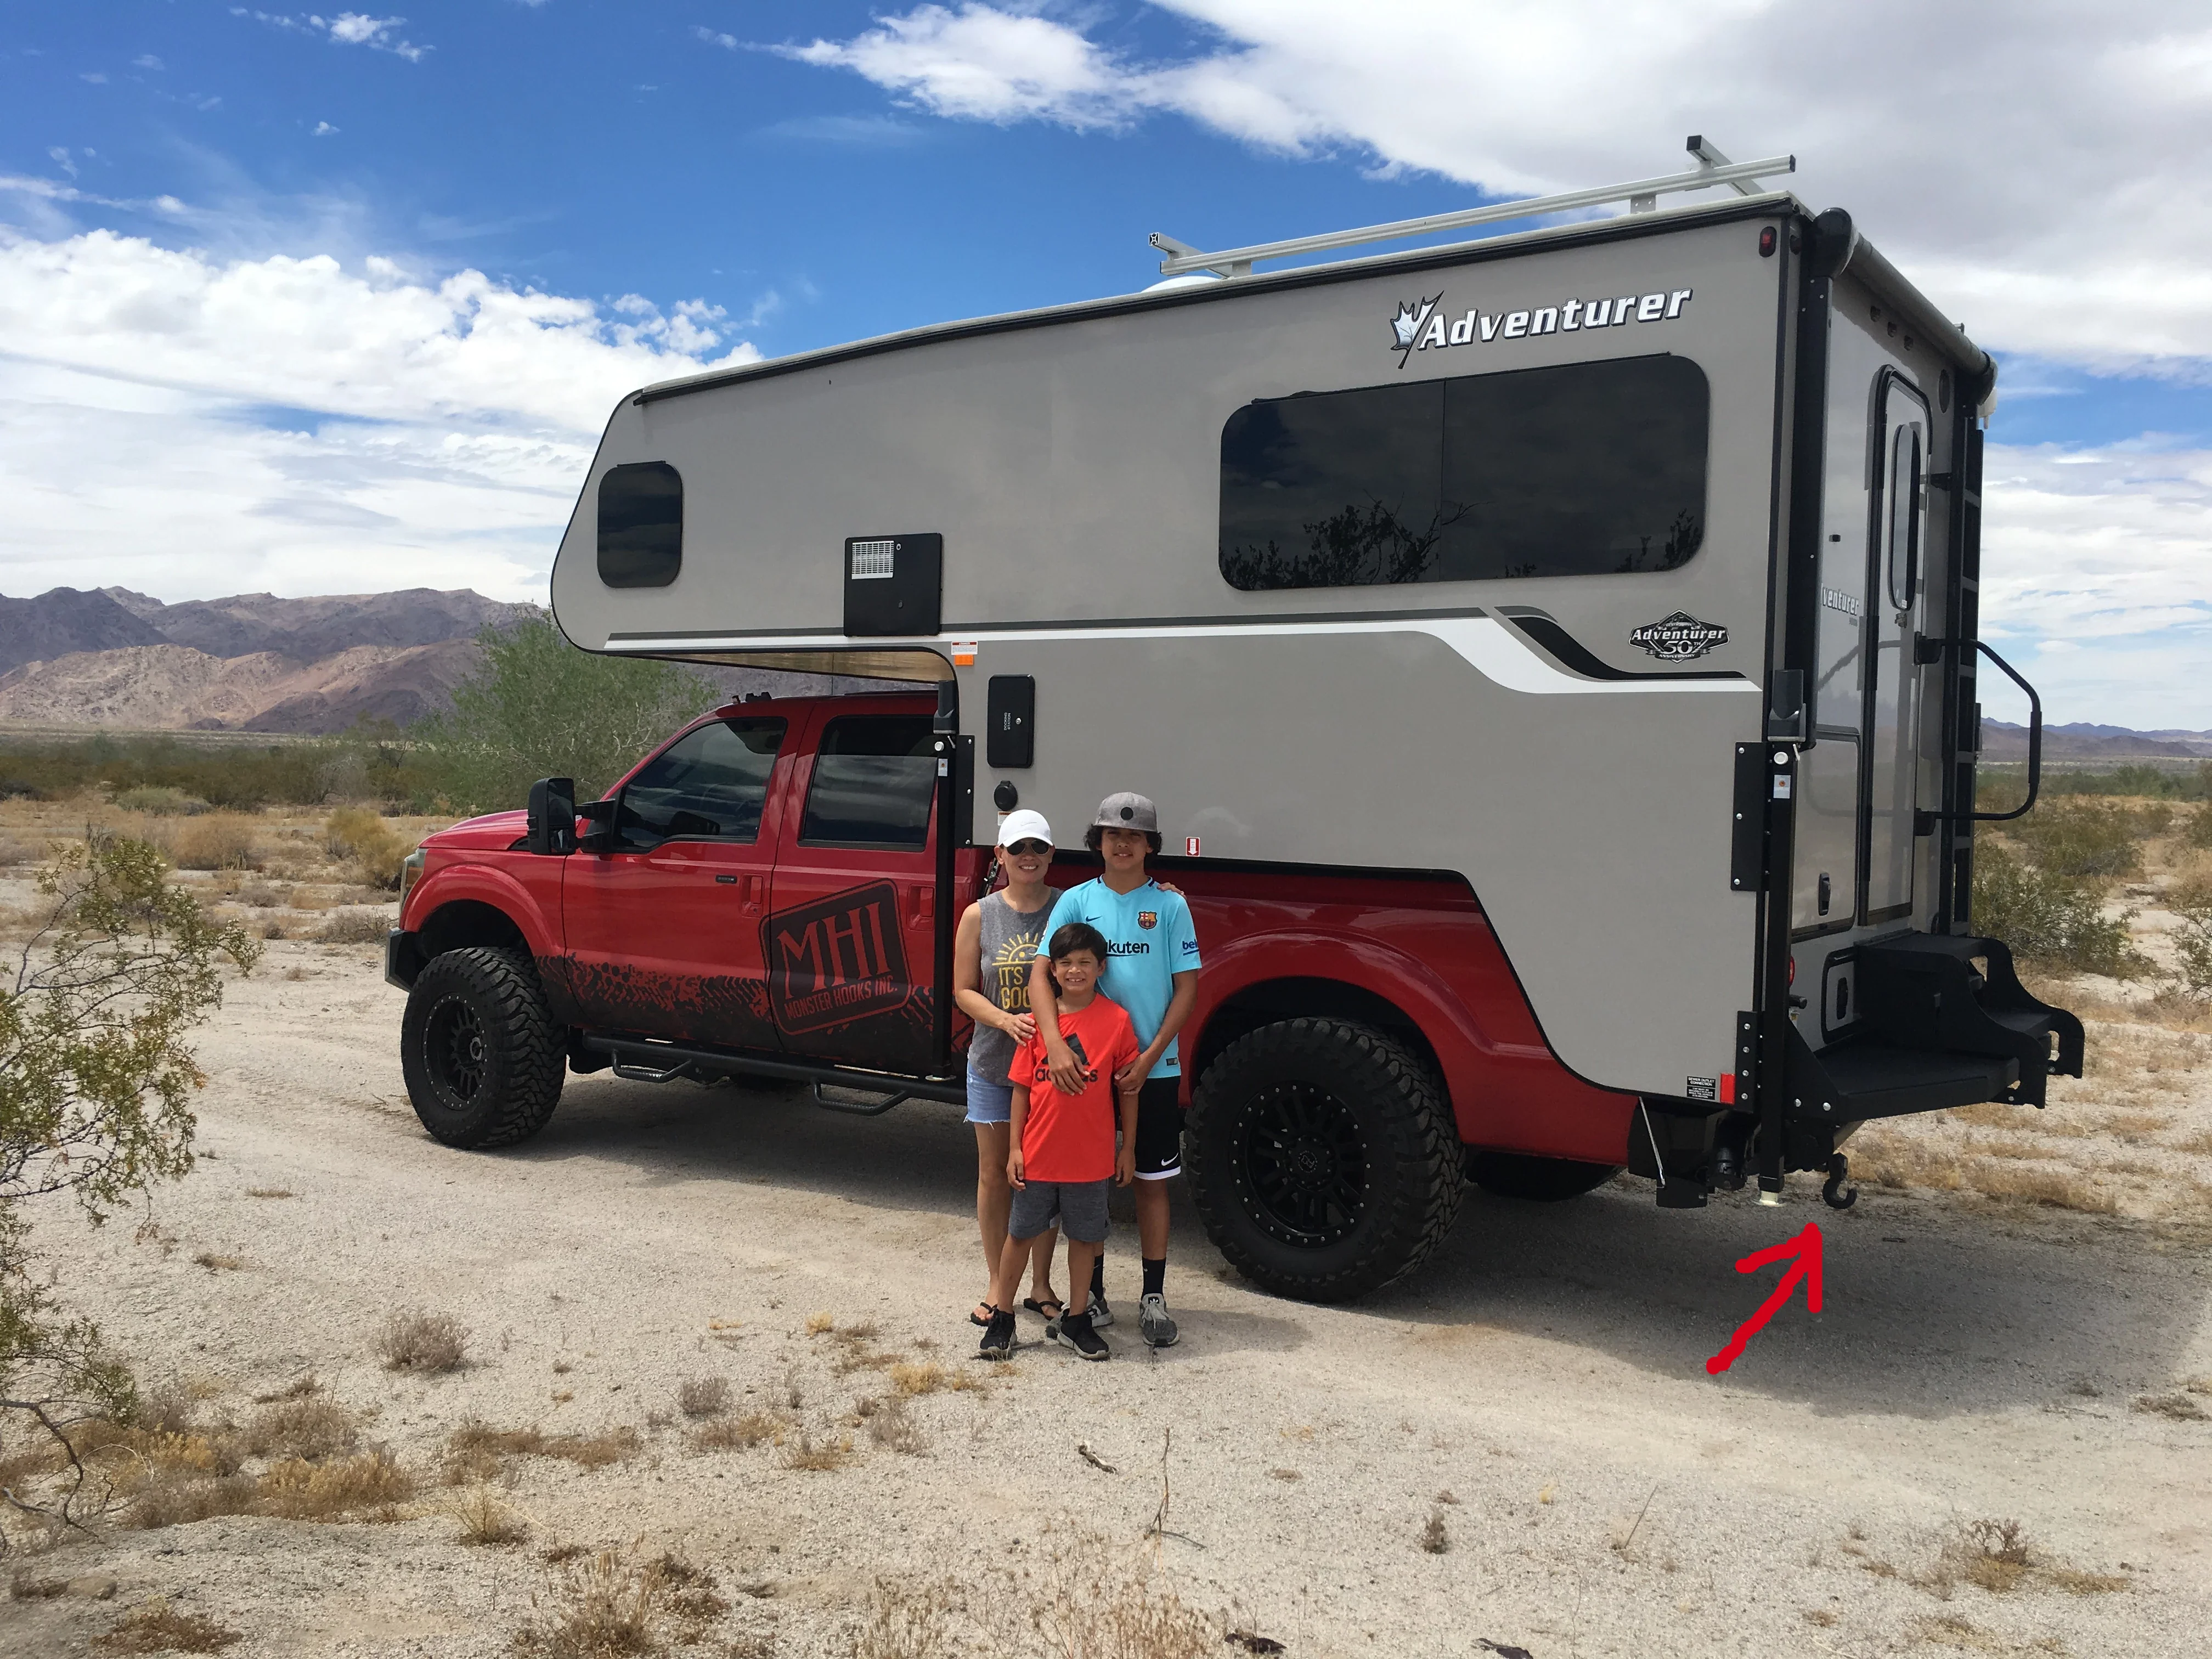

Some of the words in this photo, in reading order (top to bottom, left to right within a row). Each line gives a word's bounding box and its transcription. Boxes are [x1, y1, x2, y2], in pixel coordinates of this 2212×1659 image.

[1417, 287, 1694, 351] Adventurer
[1632, 629, 1726, 640] Adventurer
[776, 902, 891, 1000] MHI
[1106, 939, 1150, 954] kuten
[999, 966, 1023, 985] IT'S
[783, 991, 833, 1020] MONSTER
[833, 980, 872, 1007] HOOKS
[875, 974, 898, 997] INC.
[1001, 986, 1031, 1009] GOO
